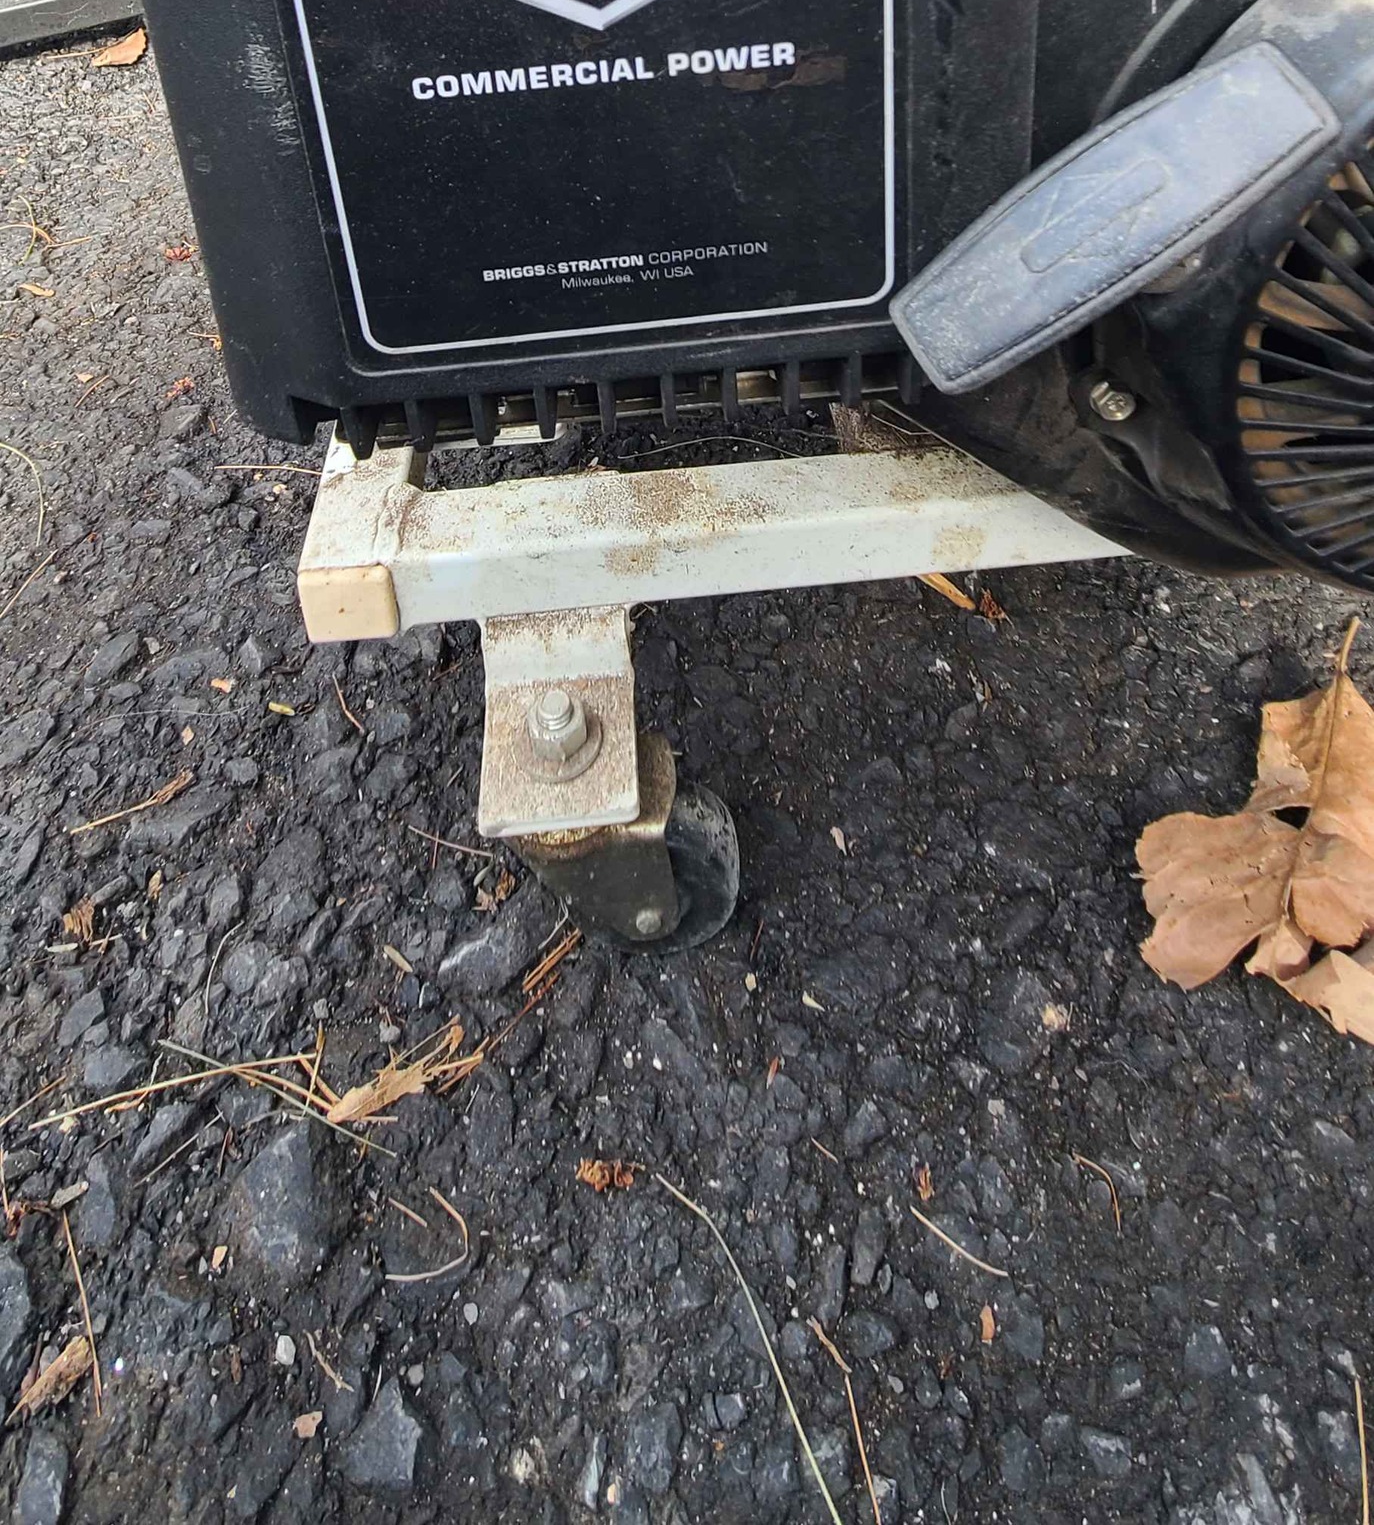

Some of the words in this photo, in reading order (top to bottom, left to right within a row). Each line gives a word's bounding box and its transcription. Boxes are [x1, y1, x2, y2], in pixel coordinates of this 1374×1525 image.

[411, 56, 653, 100] COMMERCIAL
[667, 41, 796, 77] POWER
[482, 254, 644, 282] BRIGGS&STRATTON
[648, 241, 768, 265] CORPORATION
[640, 267, 660, 281] WI
[664, 265, 694, 279] USA
